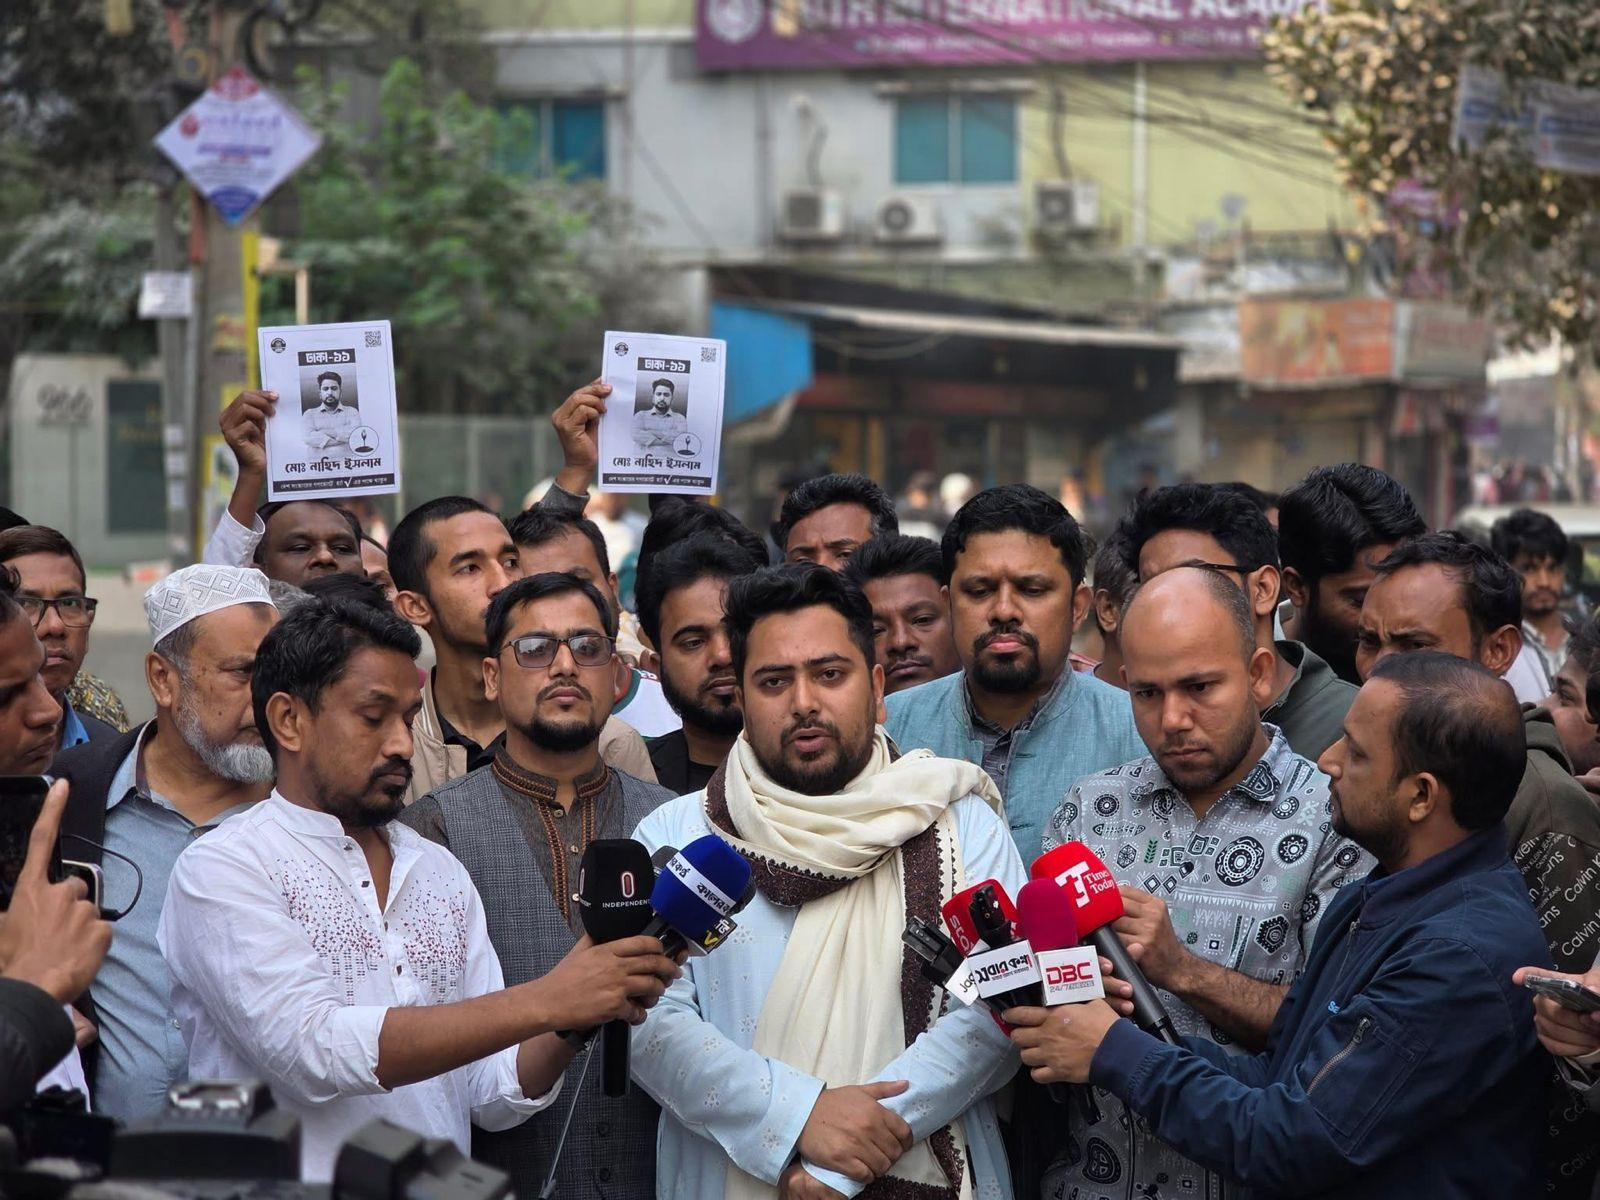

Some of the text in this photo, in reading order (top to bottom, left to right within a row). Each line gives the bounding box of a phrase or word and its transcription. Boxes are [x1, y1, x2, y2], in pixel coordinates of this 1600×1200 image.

[306, 350, 350, 364] ঢাকা-১১
[644, 359, 686, 372] ঢাকা-১১
[285, 456, 382, 474] মোঃ নাহিদ ইসলাম
[613, 453, 701, 470] মোঃ নাহিদ ইসলাম
[1564, 867, 1598, 902] Calvin
[1539, 905, 1561, 928] ans
[1561, 920, 1600, 956] Calvin
[1046, 962, 1093, 985] DBC
